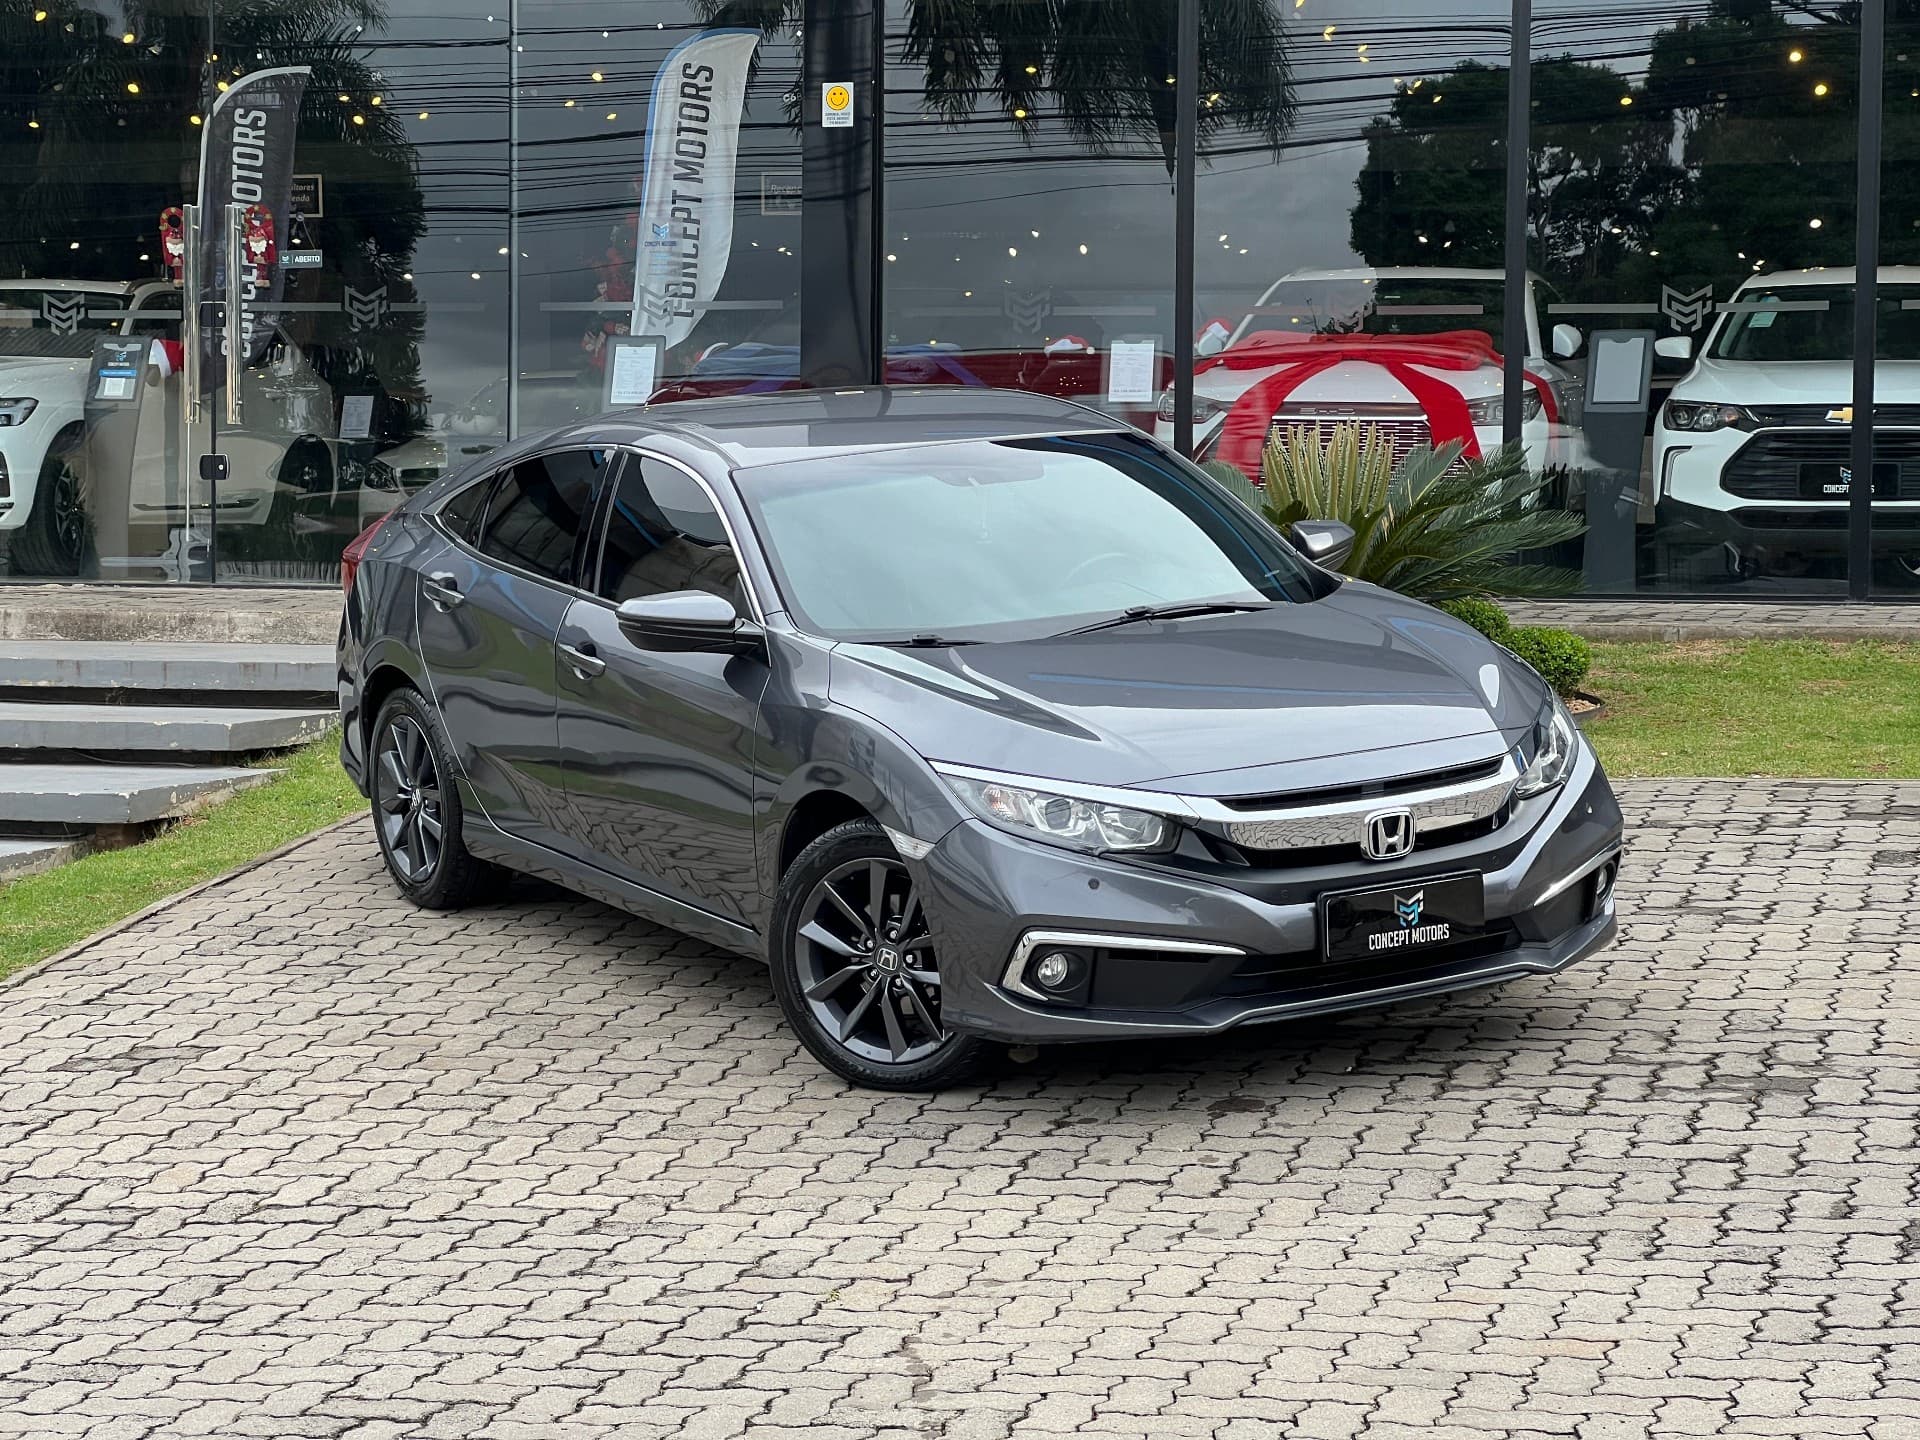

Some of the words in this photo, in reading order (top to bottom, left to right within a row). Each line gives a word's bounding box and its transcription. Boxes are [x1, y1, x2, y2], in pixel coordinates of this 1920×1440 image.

[672, 62, 714, 184] MOTORS
[231, 108, 267, 210] OTORS
[294, 255, 320, 264] ABERTO
[1823, 484, 1850, 493] CONCEPT
[1368, 929, 1409, 951] CONCEPT
[1411, 923, 1450, 944] MOTORS
